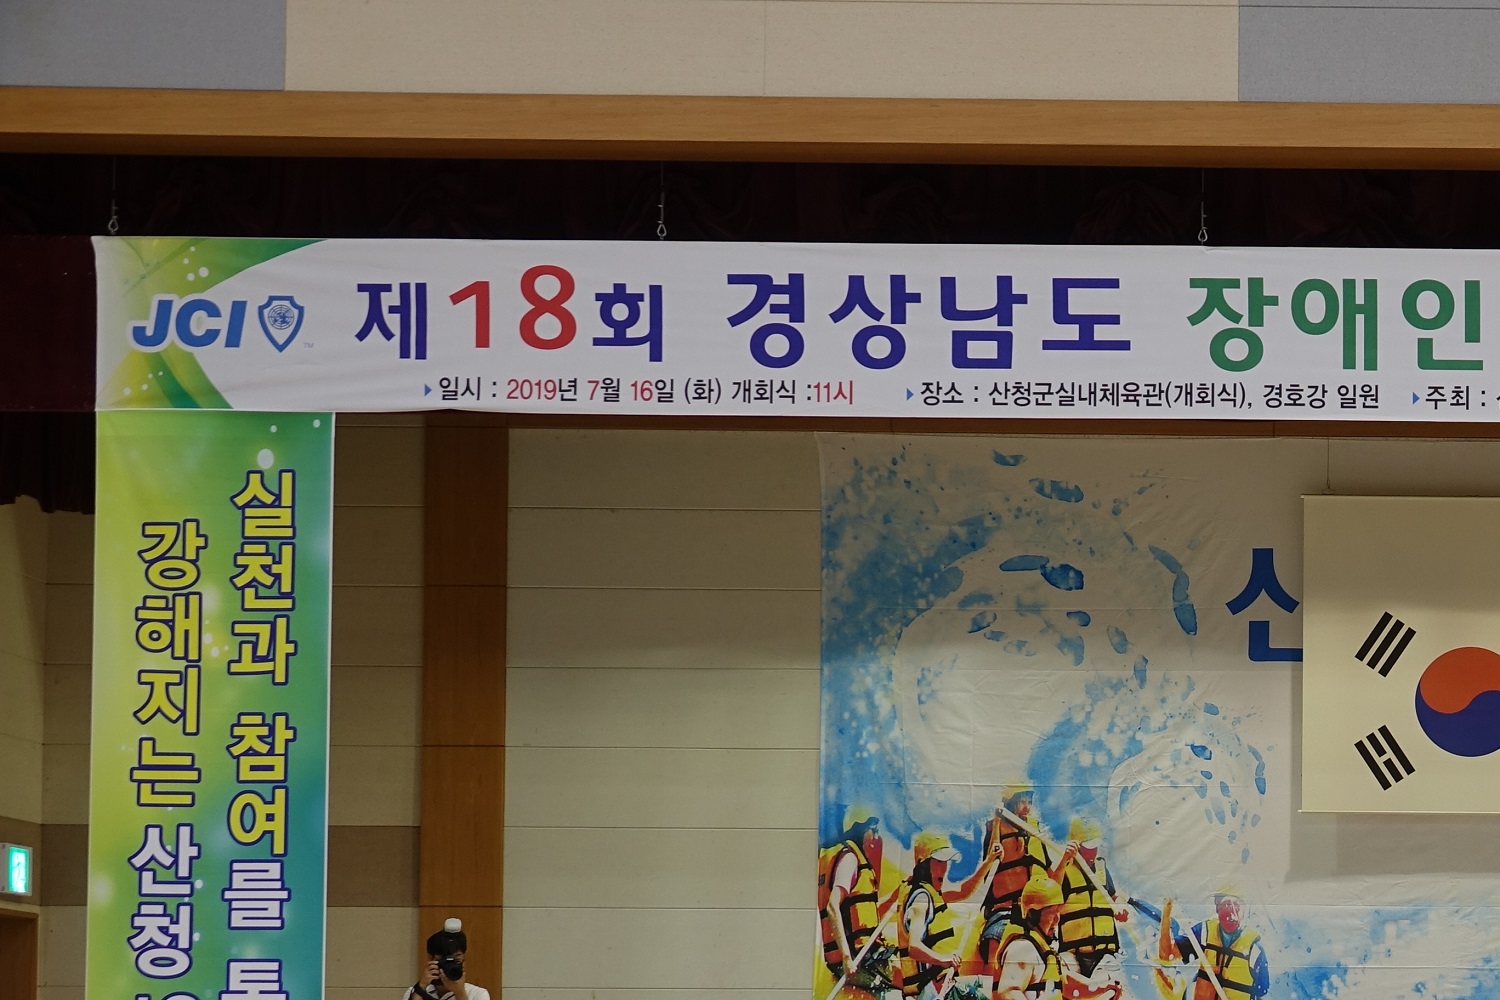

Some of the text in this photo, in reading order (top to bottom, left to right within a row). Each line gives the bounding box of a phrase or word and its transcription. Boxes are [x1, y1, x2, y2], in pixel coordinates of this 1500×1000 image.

[131, 296, 247, 351] JCI
[354, 264, 665, 363] 제18회
[725, 273, 1133, 371] 경상남도
[1186, 277, 1485, 373] 장애인
[439, 377, 481, 401] 일시
[506, 378, 578, 401] 2019년
[587, 377, 621, 403] 7월
[630, 378, 676, 402] 16일
[684, 377, 721, 404] (화)
[920, 381, 965, 406] 장소
[988, 381, 1252, 409] 산청군실내체육관(개회식),
[1262, 383, 1328, 409] 경호강
[1337, 384, 1380, 409] 일원
[1424, 385, 1471, 411] 주최
[227, 469, 297, 686] 실천과
[130, 519, 208, 808] 강해지는
[221, 711, 297, 931] 참여를
[127, 822, 202, 979] 산청
